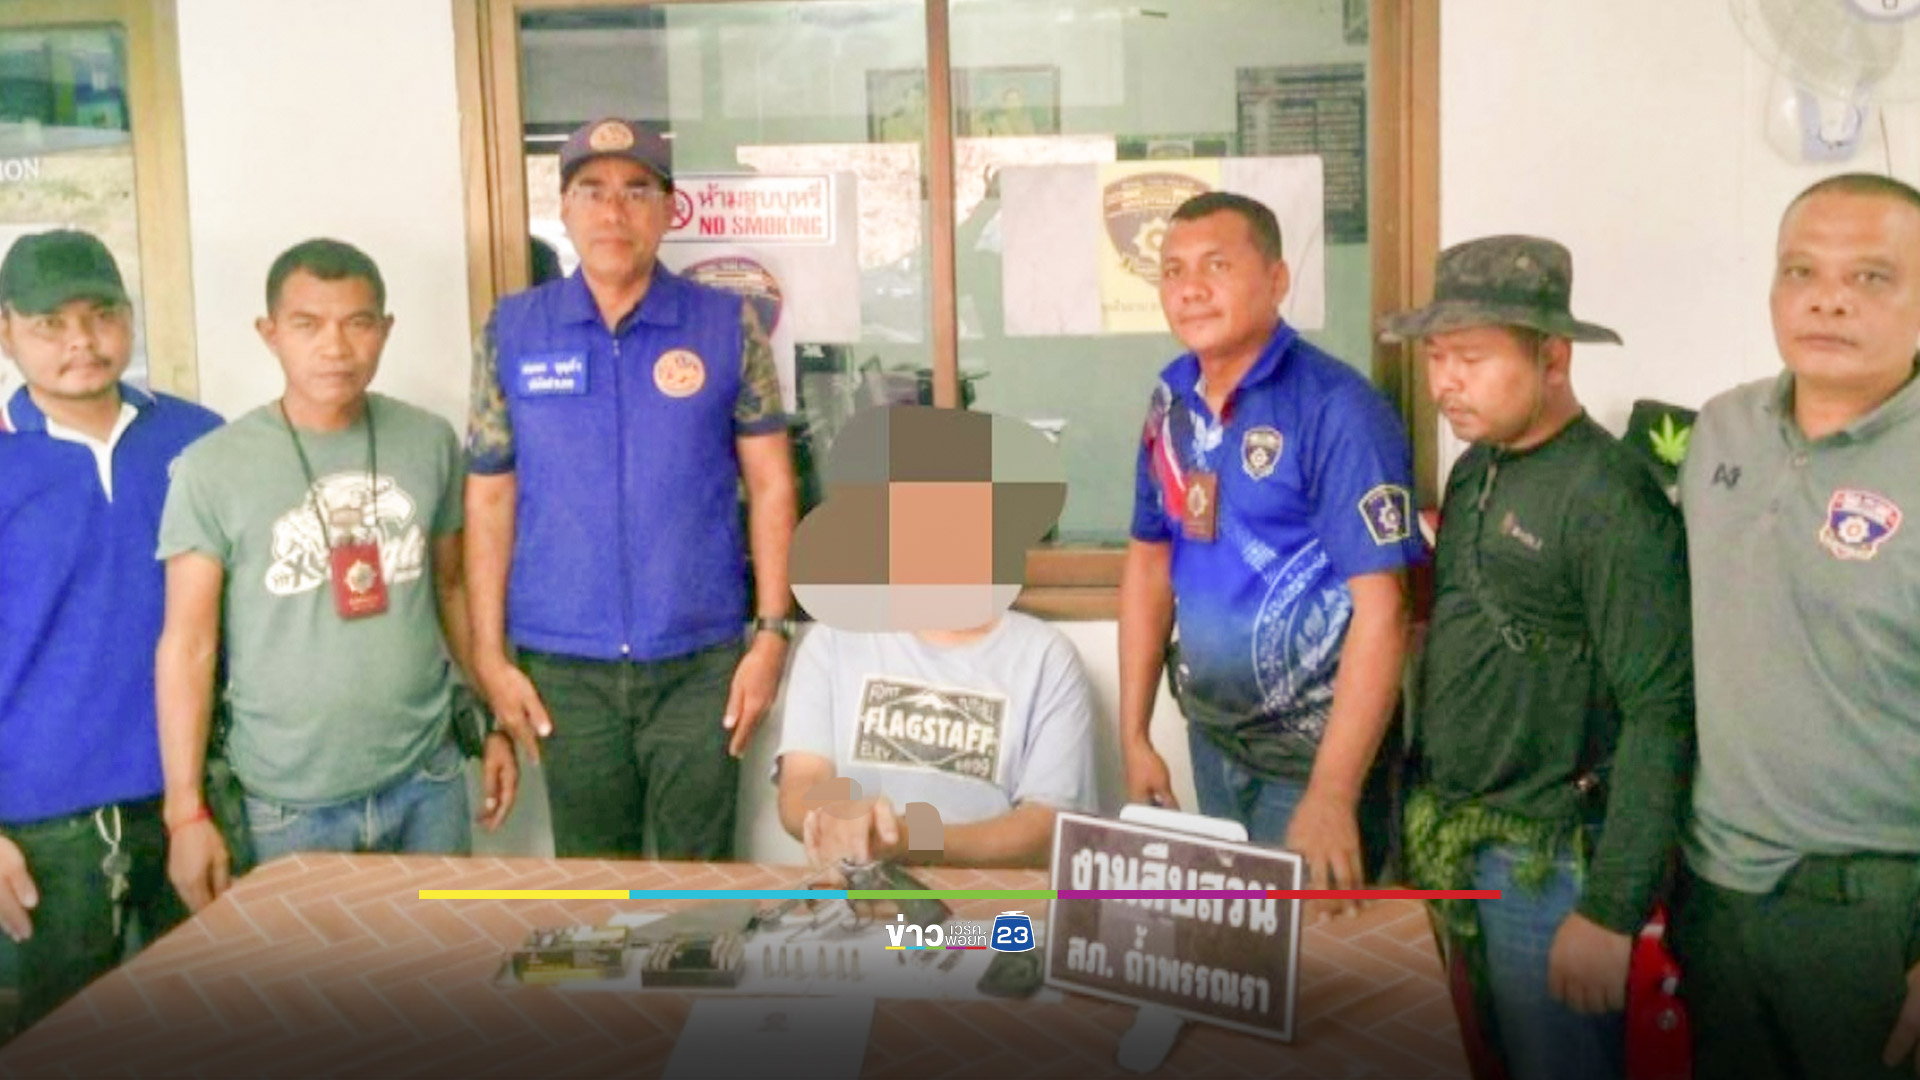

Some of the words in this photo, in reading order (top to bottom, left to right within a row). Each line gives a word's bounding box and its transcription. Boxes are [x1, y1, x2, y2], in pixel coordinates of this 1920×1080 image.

[700, 215, 726, 236] NO
[732, 215, 822, 236] SMOKING
[863, 706, 996, 754] FLAGSTAFF
[1071, 843, 1278, 935] งานสืบสวน
[1066, 936, 1114, 979] สภ.
[1124, 924, 1271, 1014] ถ้ำพรรณรา
